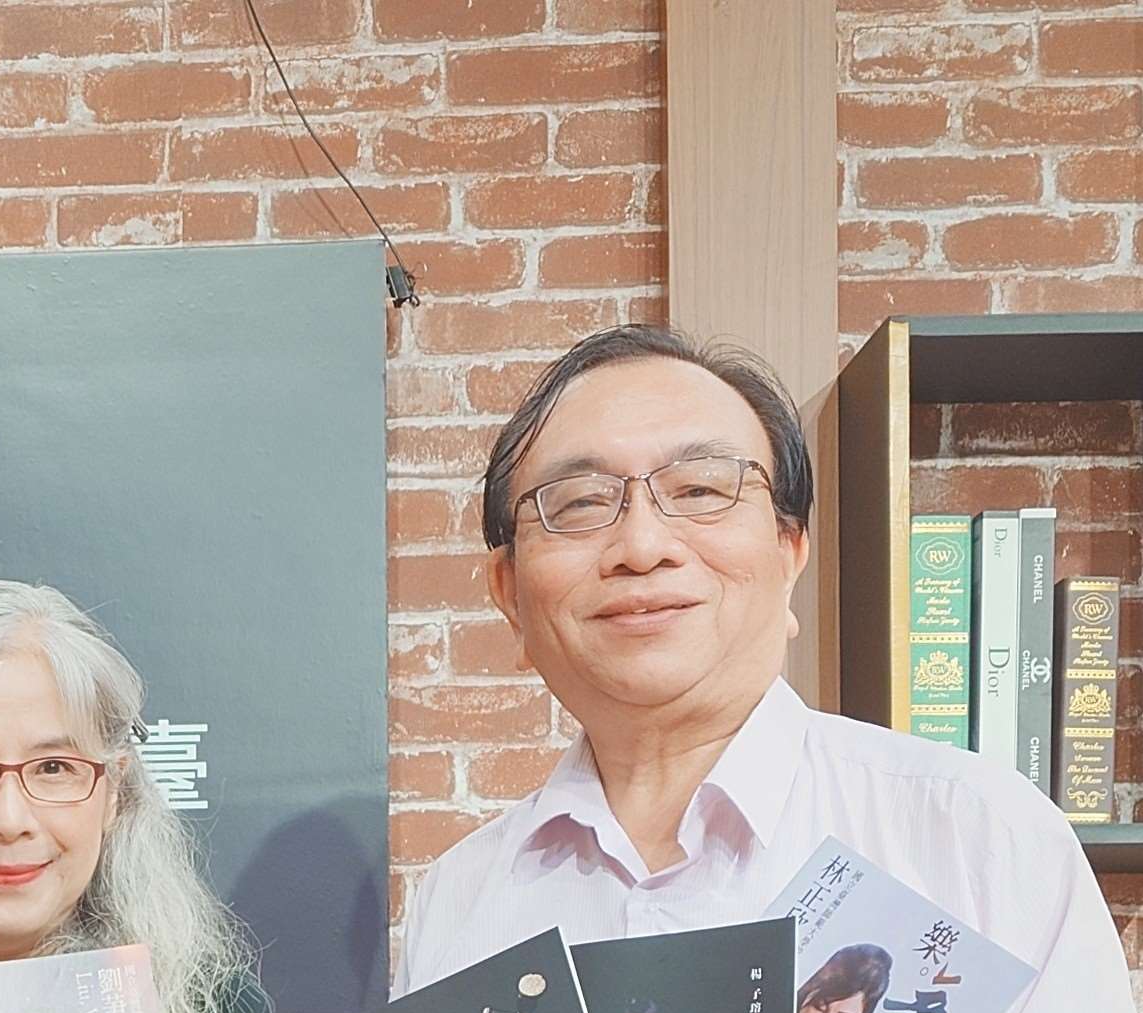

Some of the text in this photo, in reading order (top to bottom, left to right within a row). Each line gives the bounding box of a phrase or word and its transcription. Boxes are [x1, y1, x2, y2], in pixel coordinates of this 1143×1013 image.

[929, 549, 952, 563] RW
[1033, 554, 1044, 604] CHANEL
[1084, 603, 1104, 615] RW
[988, 648, 1010, 698] Dior
[1022, 650, 1031, 690] CHANEL
